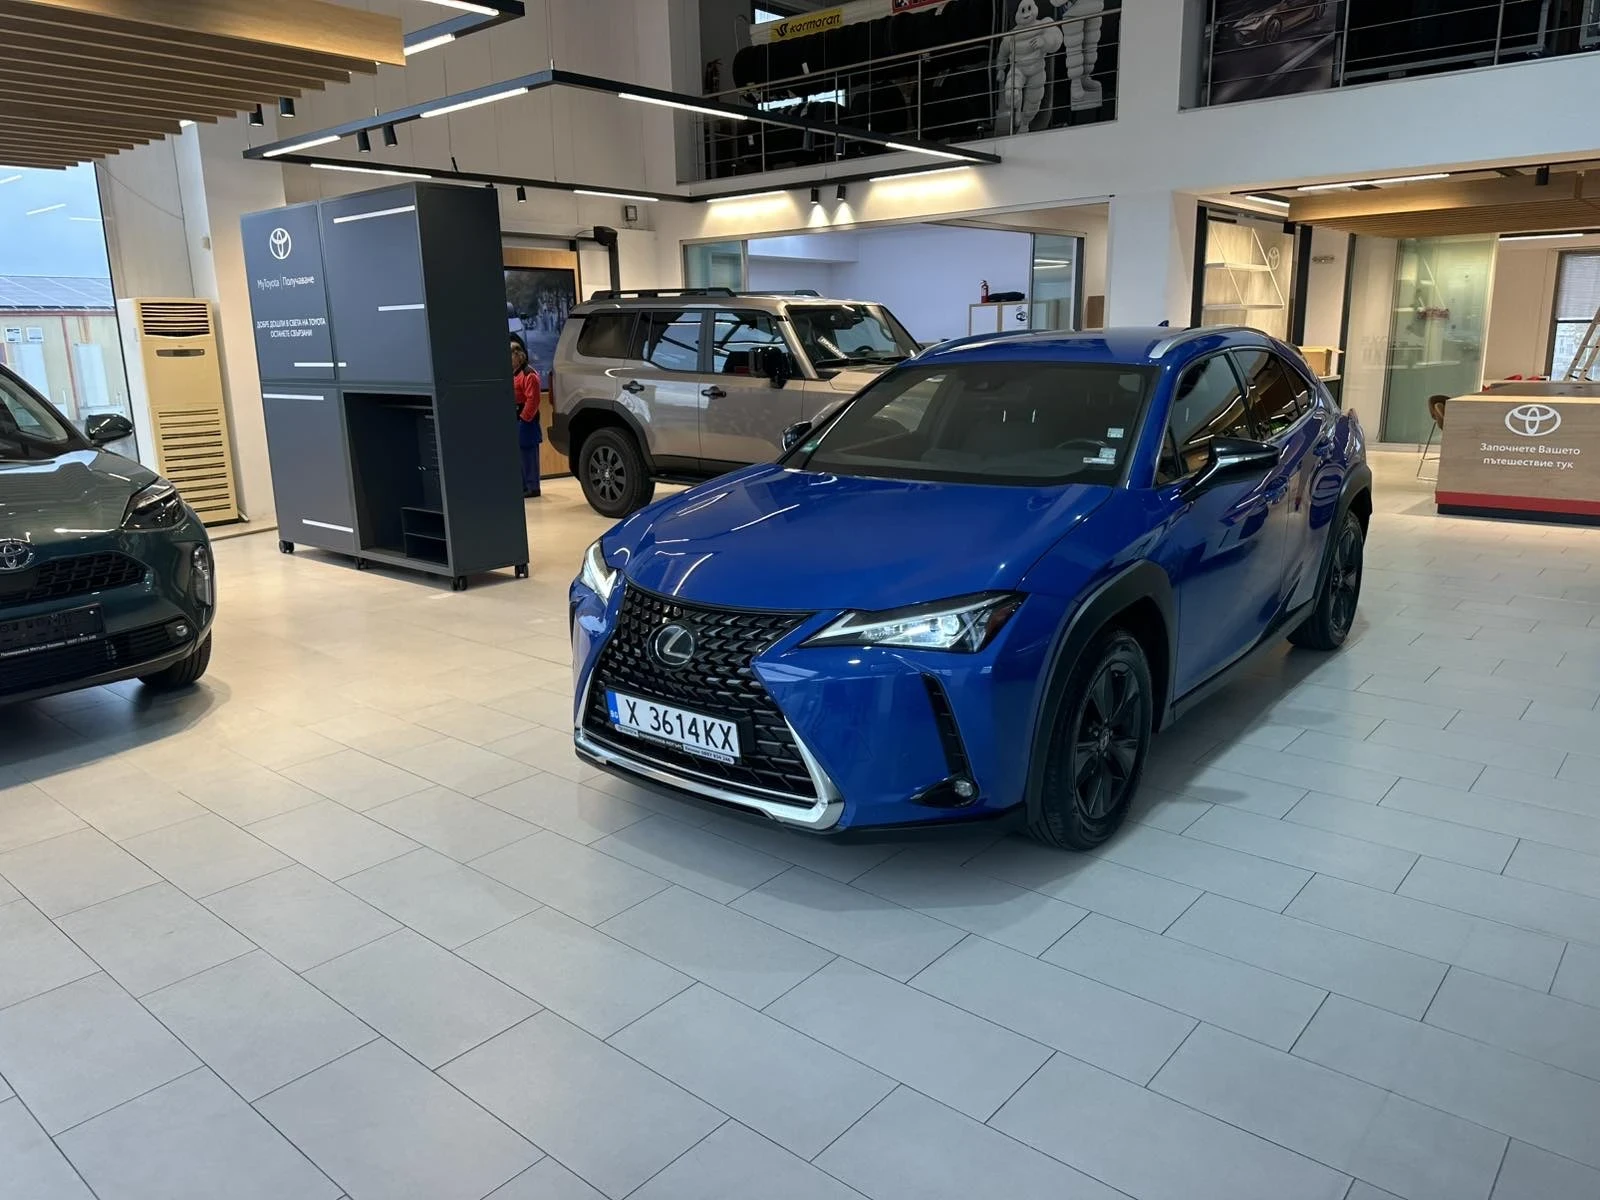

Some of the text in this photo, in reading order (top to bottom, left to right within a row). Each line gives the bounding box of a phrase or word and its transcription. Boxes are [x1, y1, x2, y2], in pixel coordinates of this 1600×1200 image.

[789, 14, 841, 33] kormoran
[1480, 442, 1581, 456] Започнете Вашето
[1483, 457, 1574, 471] пътешествие тук
[625, 698, 640, 727] X
